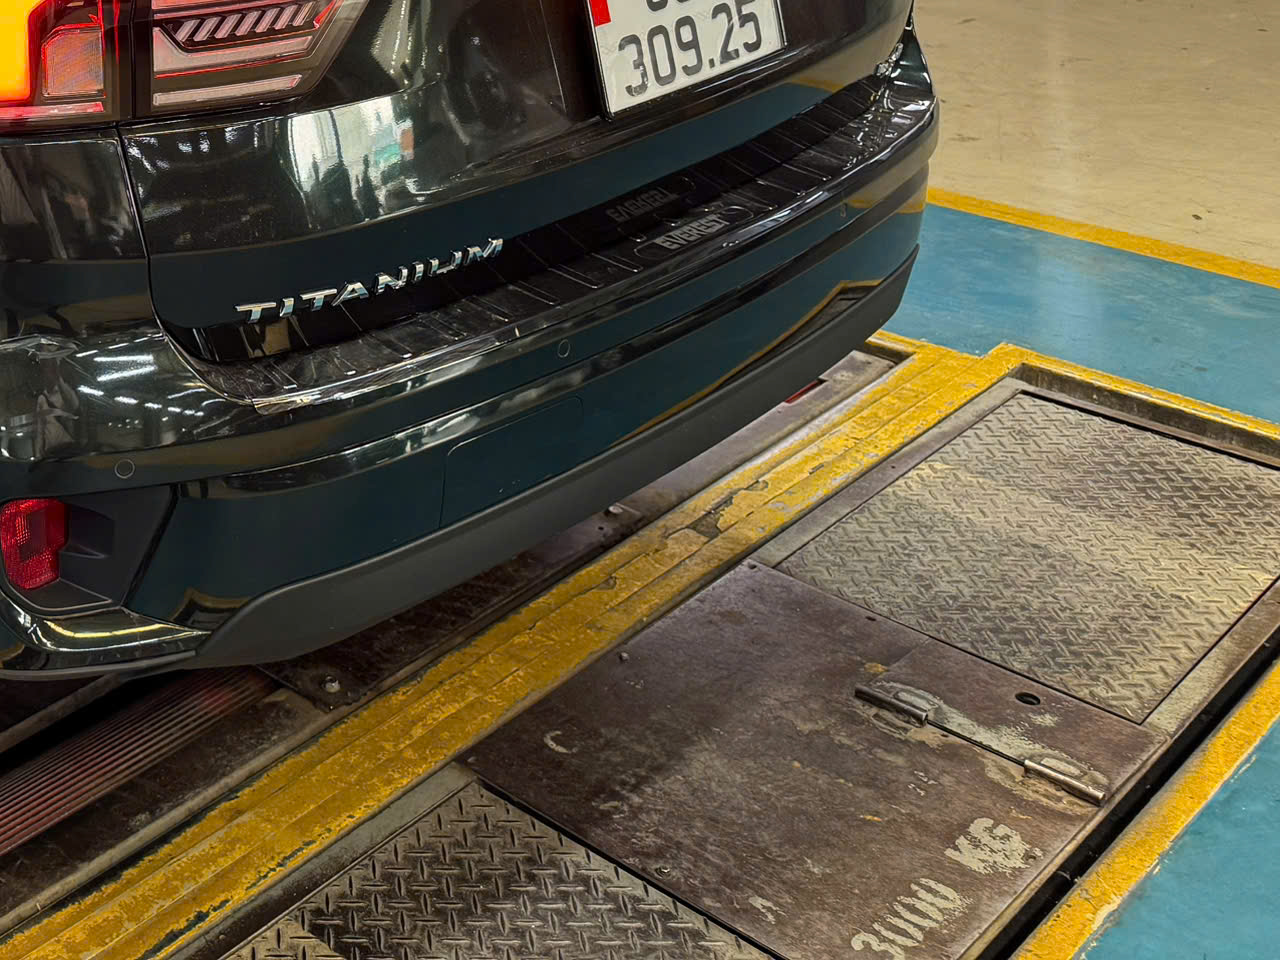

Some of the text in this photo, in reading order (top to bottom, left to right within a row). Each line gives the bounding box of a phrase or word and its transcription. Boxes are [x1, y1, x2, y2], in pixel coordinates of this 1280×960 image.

[654, 212, 730, 250] EVEREST
[234, 237, 504, 324] TITANIUM
[944, 817, 1043, 878] KG
